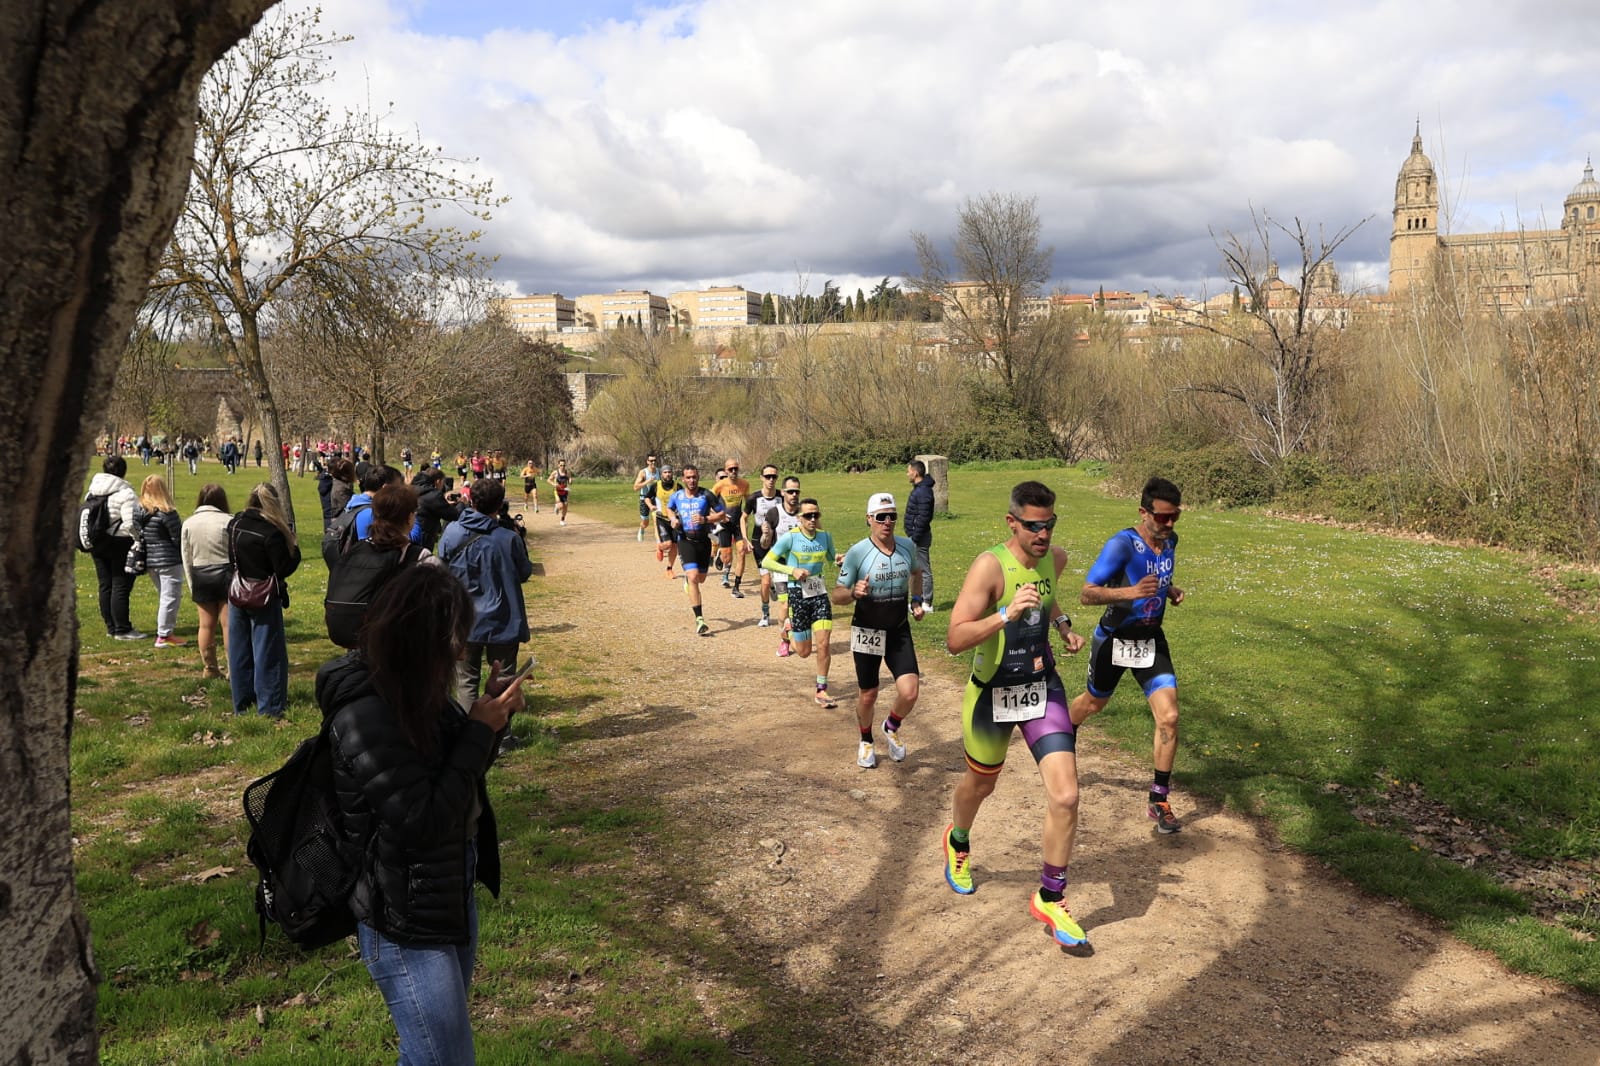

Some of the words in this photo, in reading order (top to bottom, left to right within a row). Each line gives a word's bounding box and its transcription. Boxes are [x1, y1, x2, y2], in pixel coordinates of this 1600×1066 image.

[1146, 558, 1172, 574] HARO
[1016, 577, 1051, 596] TOS
[856, 634, 881, 647] 1242
[1119, 646, 1149, 659] 1128
[1001, 692, 1039, 708] 1149
